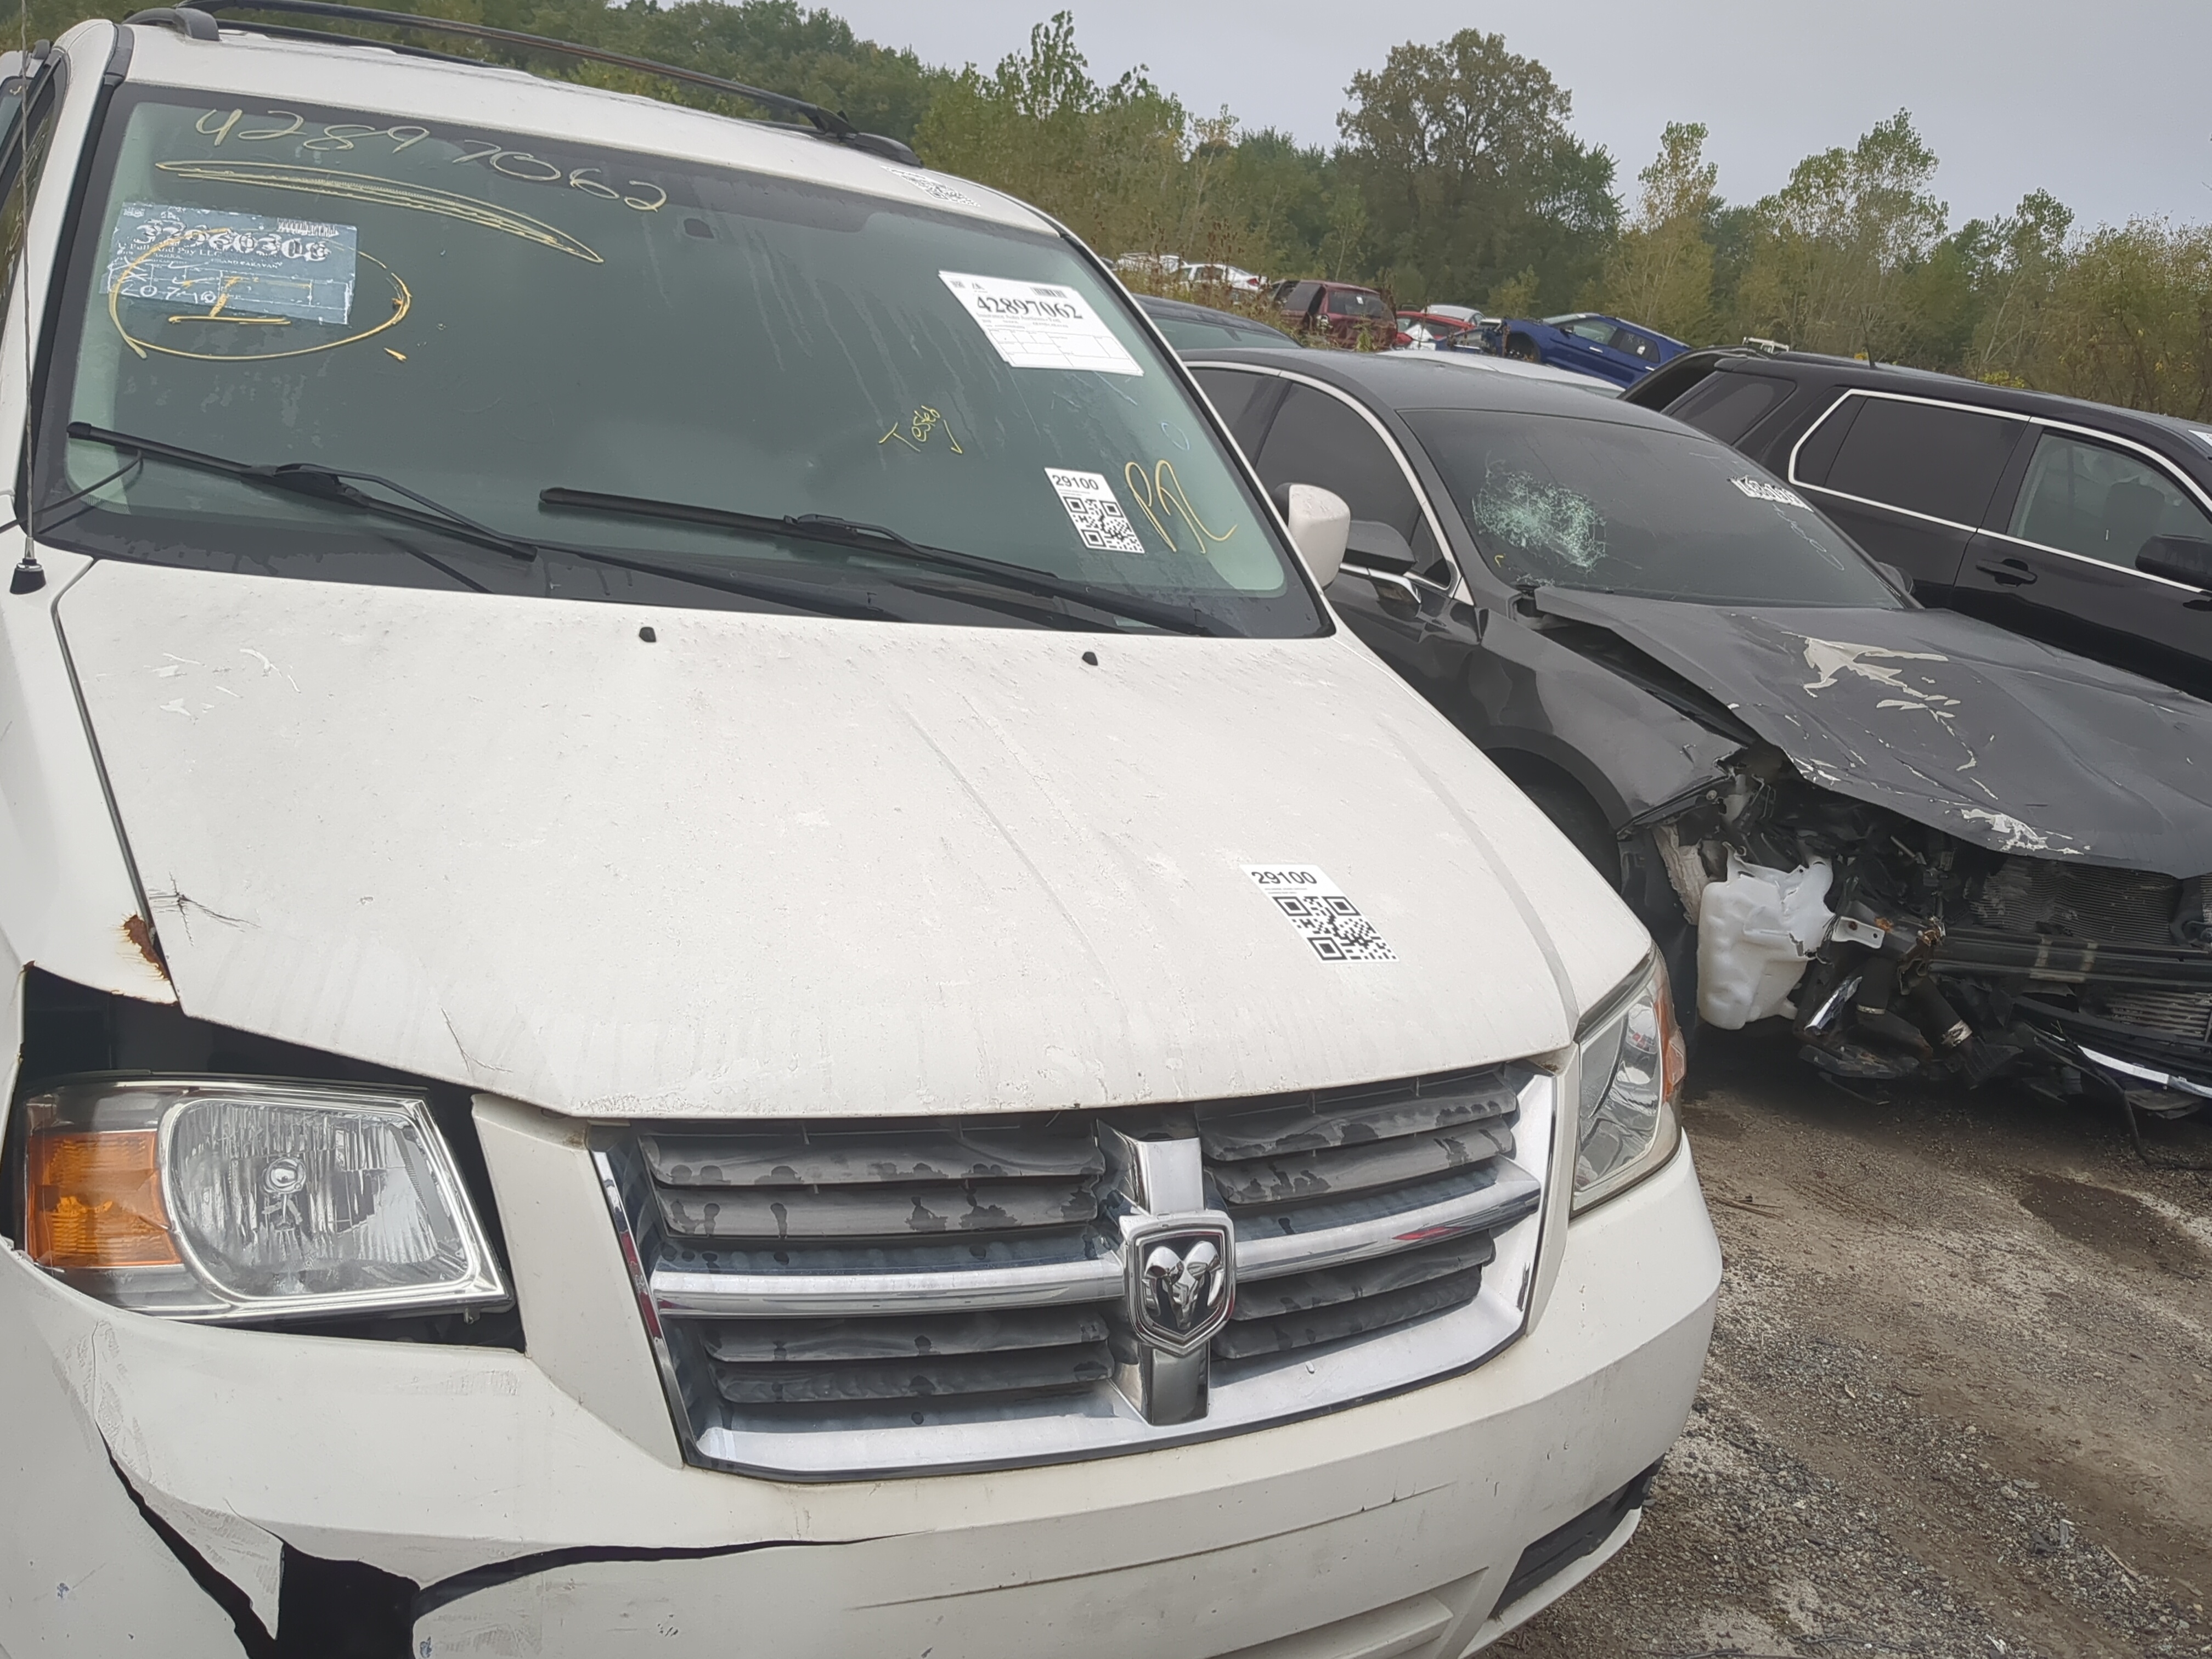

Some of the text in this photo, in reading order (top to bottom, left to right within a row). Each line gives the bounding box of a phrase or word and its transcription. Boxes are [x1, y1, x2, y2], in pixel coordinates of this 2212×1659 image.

[977, 296, 1084, 319] 42897062
[1052, 475, 1099, 490] 29100
[1251, 871, 1318, 884] 29100
